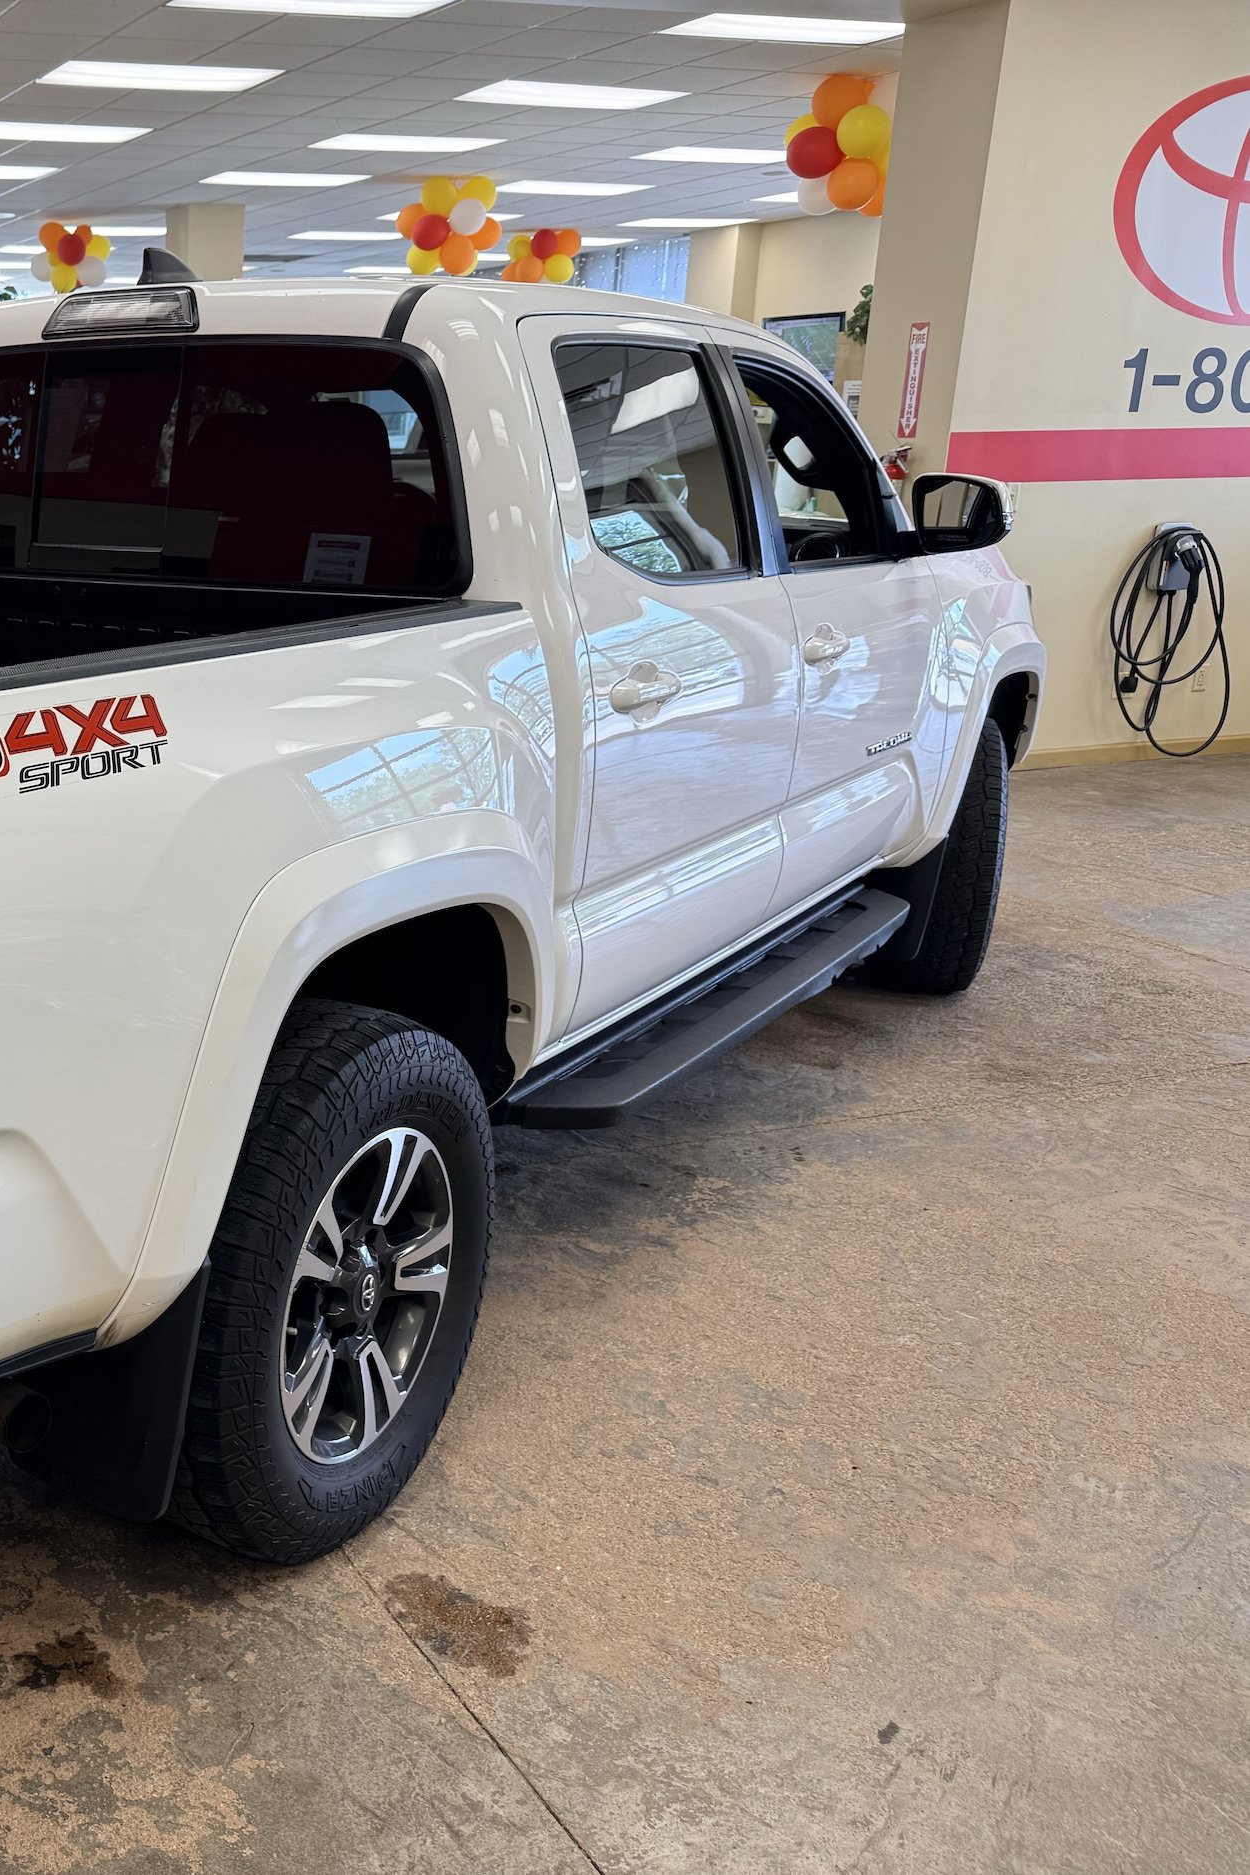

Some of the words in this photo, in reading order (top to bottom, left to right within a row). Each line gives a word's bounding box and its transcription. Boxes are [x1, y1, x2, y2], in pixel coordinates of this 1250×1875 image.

[911, 333, 927, 345] FIRE
[905, 348, 921, 430] EXTINGUISHER
[19, 739, 168, 795] SPORT
[326, 1460, 396, 1514] PINZA
